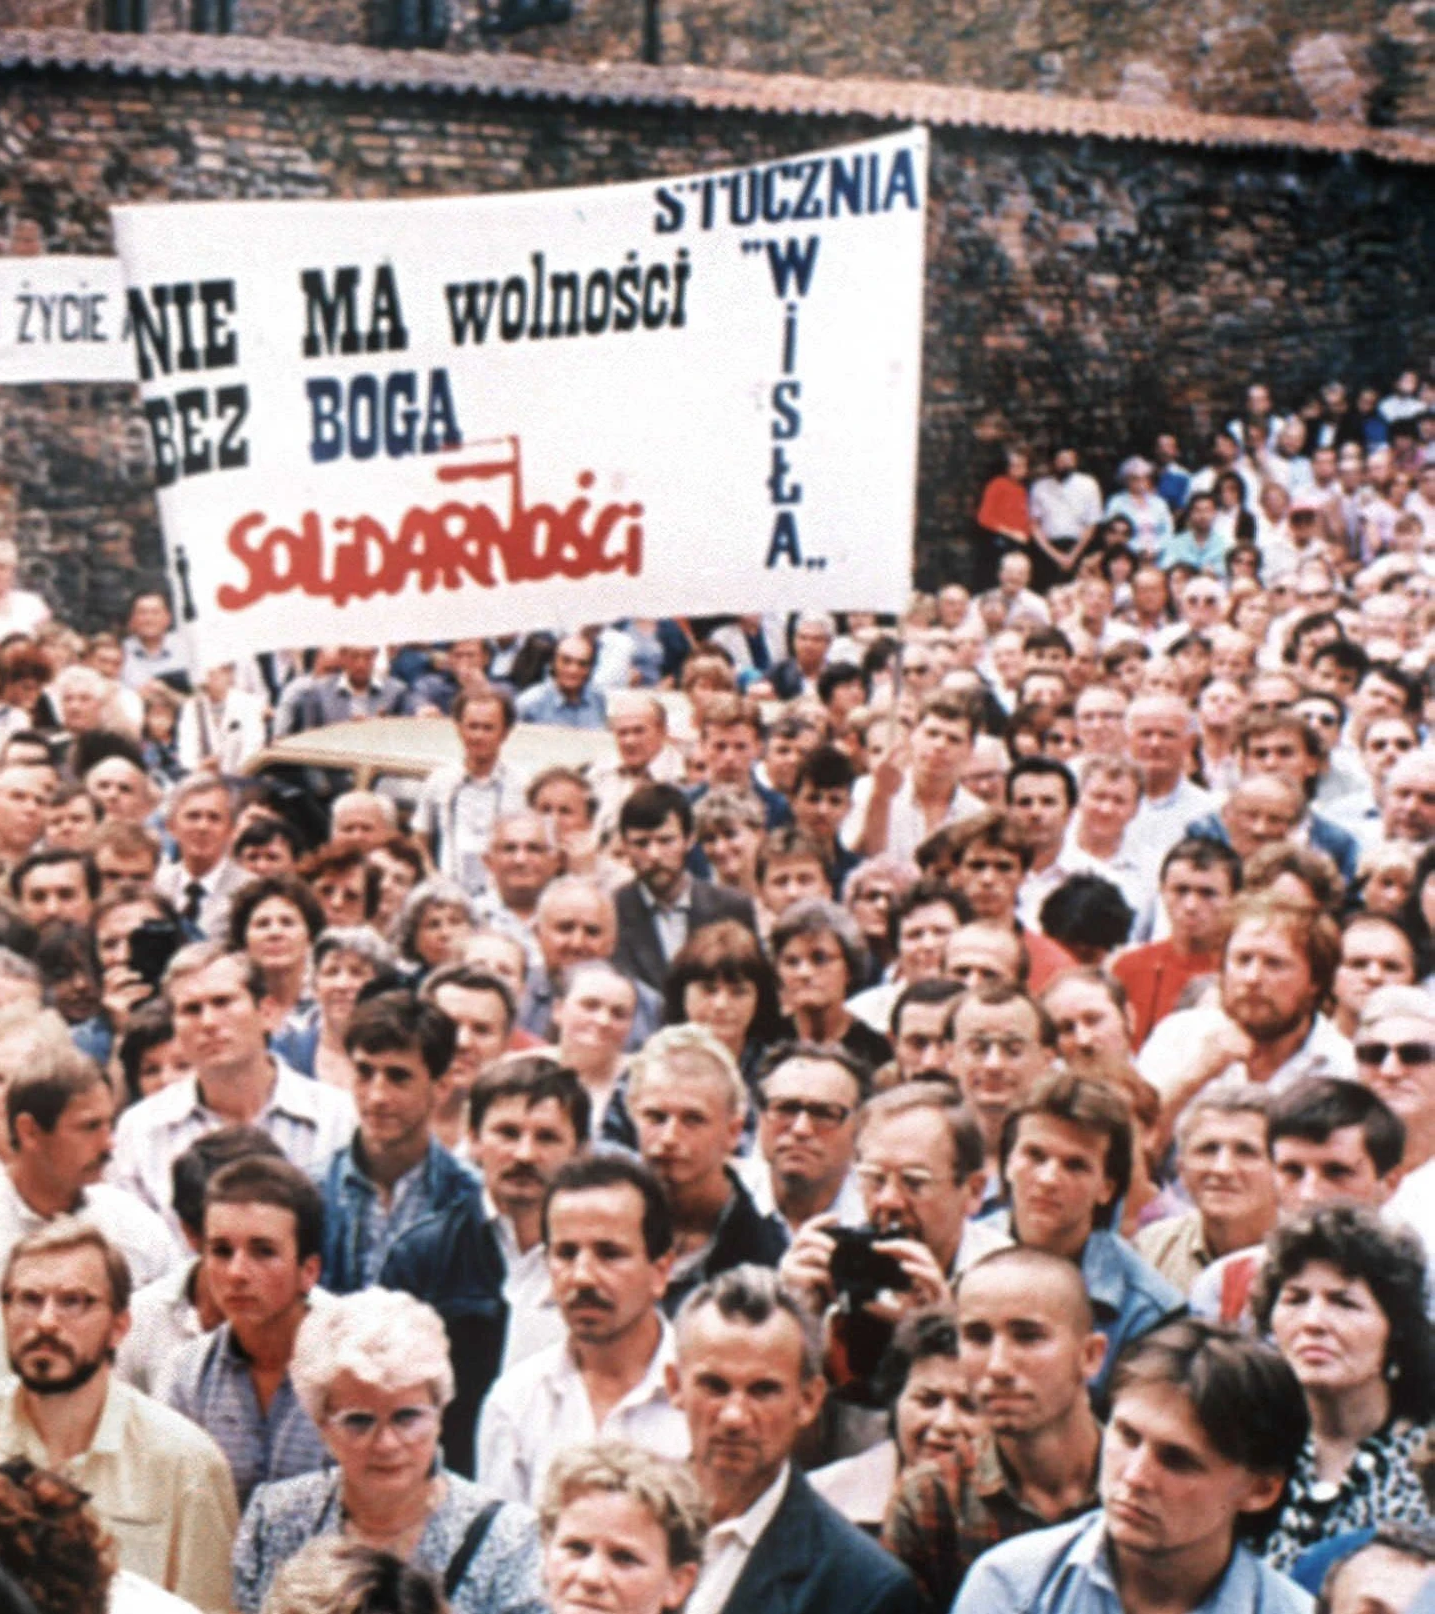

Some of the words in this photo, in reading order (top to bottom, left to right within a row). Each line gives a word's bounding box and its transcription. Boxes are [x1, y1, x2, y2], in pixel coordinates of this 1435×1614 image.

[125, 277, 239, 382] NIE
[299, 261, 410, 358] MA
[444, 246, 692, 347] wolności
[144, 383, 250, 488] BEZ
[305, 367, 464, 464] BOGA
